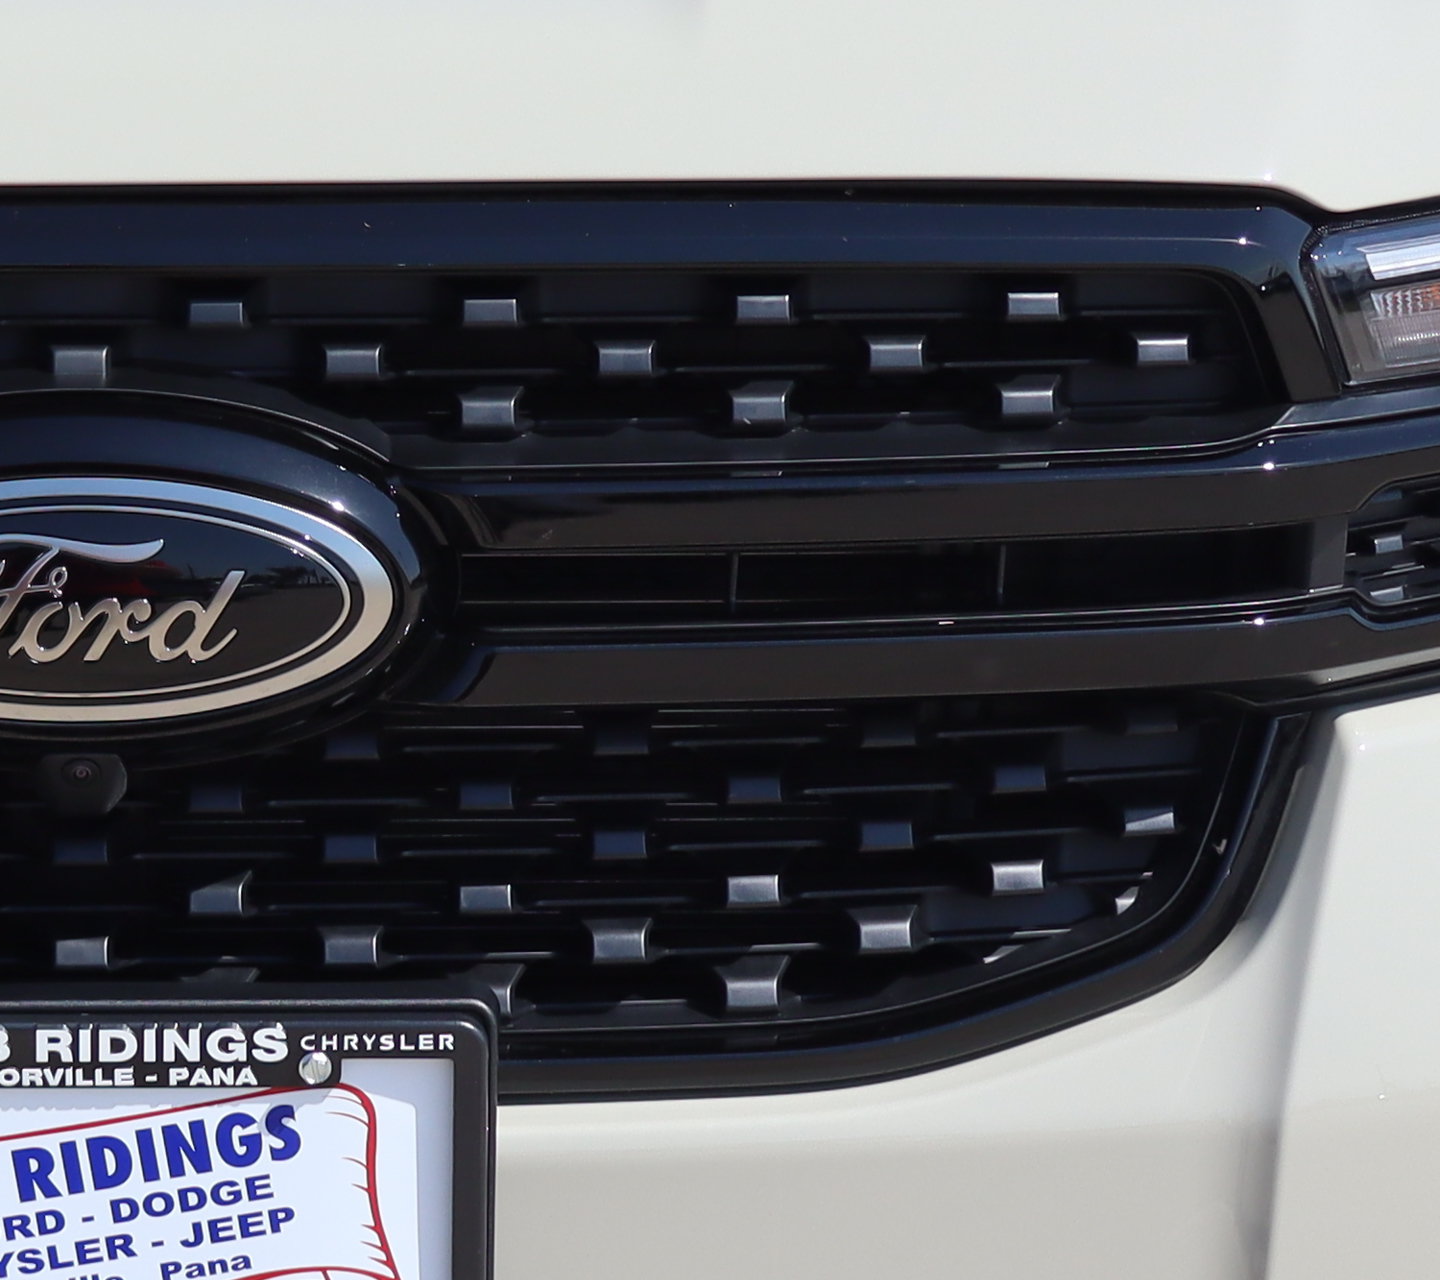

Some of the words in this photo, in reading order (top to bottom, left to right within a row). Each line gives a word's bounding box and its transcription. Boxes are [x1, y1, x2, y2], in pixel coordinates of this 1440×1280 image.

[35, 1026, 288, 1063] RIDINGS
[301, 1033, 454, 1052] CHRYSLER
[170, 1067, 258, 1087] PANA
[11, 1104, 302, 1202] RIDINGS
[110, 1174, 274, 1224] DODGE
[179, 1206, 296, 1249] JEEP
